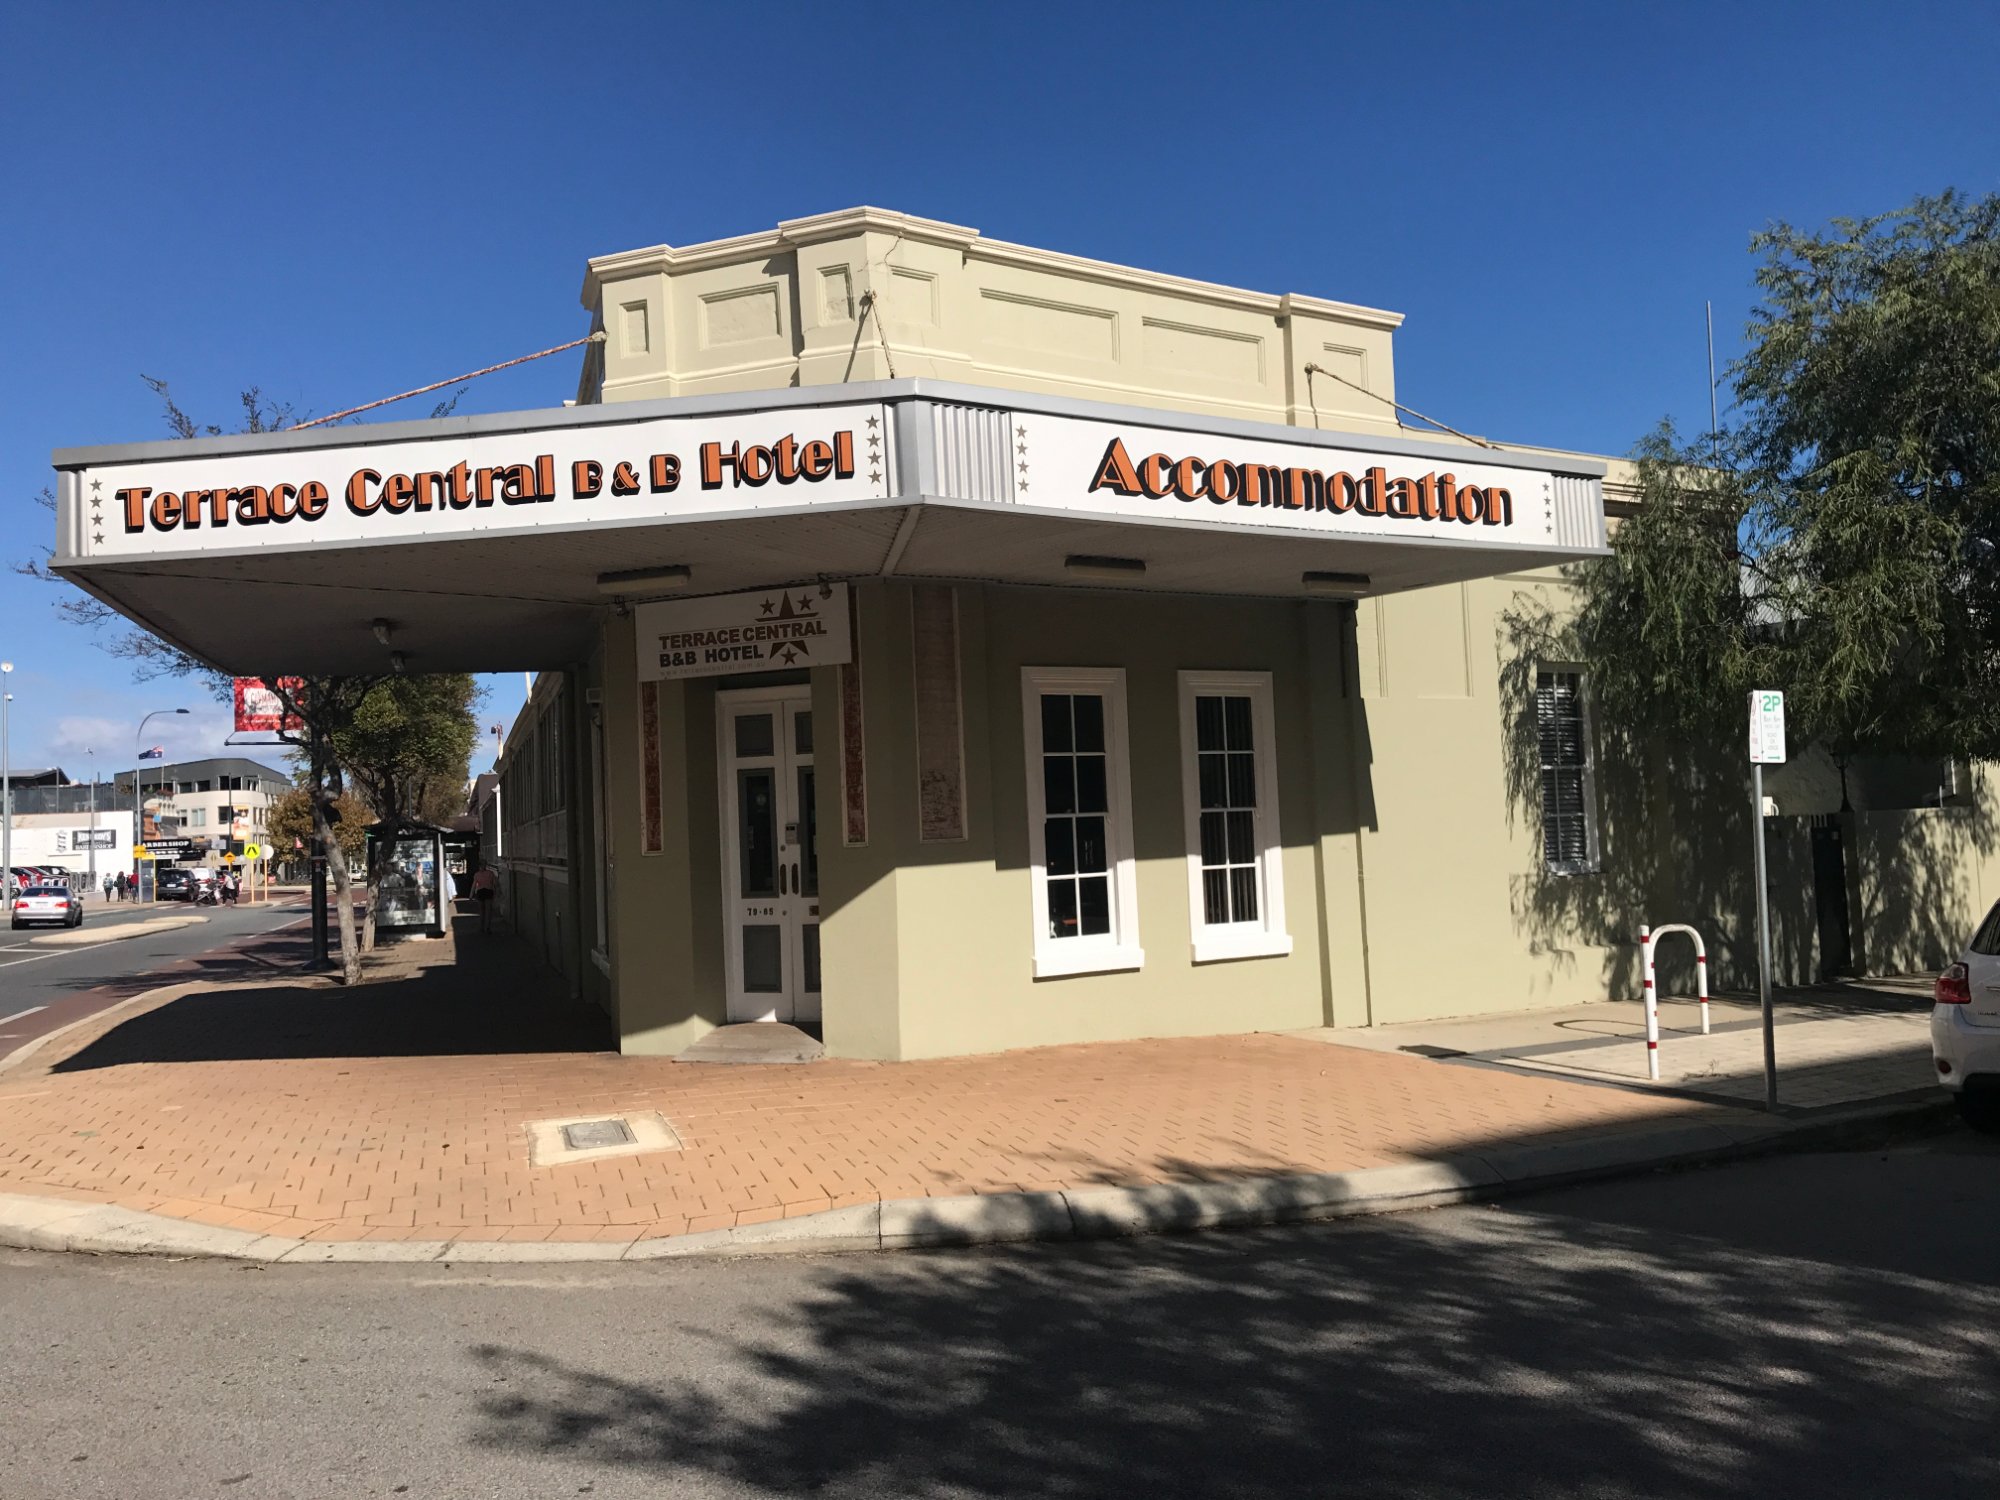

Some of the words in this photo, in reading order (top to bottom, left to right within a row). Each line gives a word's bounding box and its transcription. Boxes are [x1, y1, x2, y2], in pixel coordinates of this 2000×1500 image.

[115, 480, 329, 535] Terrace
[345, 453, 557, 517] Central
[699, 430, 855, 491] Hotel
[1087, 435, 1514, 527] Accommodation
[658, 628, 740, 650] TERRACE
[742, 620, 827, 642] CENTRAL
[659, 650, 697, 668] B&B
[705, 644, 764, 664] HOTEL
[1762, 694, 1781, 712] 2P
